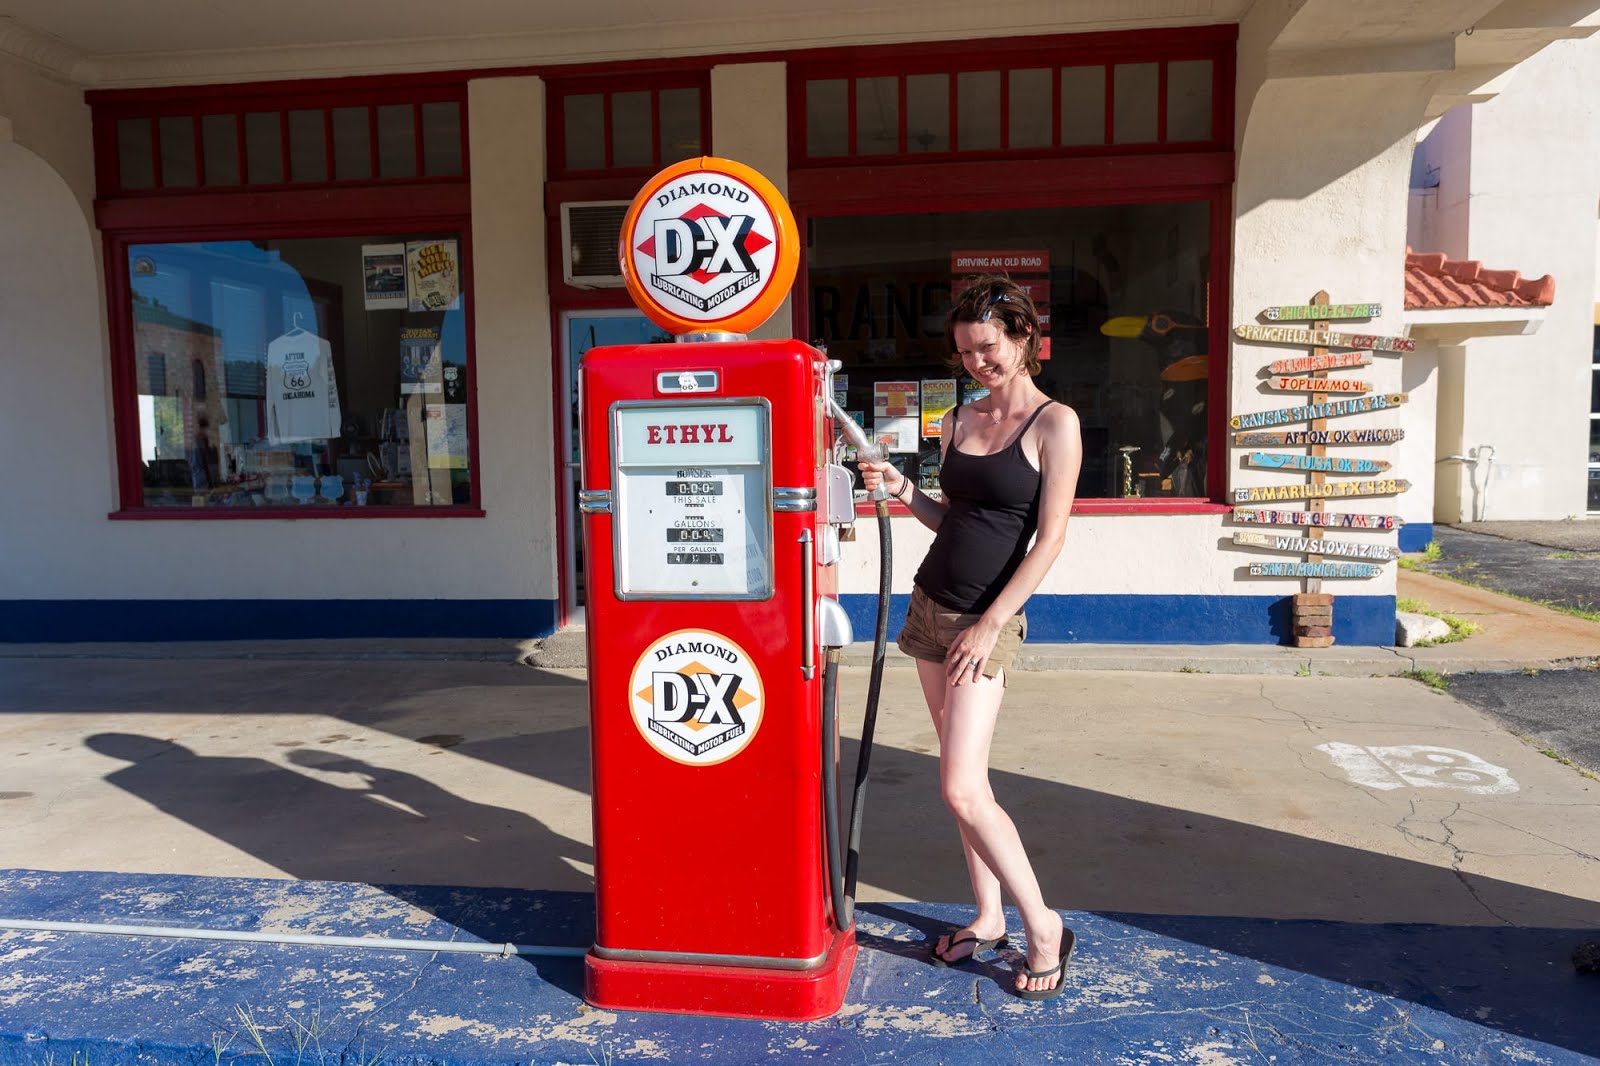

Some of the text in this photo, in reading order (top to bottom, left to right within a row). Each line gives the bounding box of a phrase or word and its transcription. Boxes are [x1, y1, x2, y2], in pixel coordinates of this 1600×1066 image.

[657, 183, 750, 208] DIAMOND
[957, 258, 1042, 267] DRIVING AN OLD ROAD
[652, 271, 759, 309] LUBRICATING MOTOR FUEL
[1280, 305, 1329, 320] CHICAGO
[1323, 332, 1341, 346] 418
[290, 376, 305, 387] 66
[283, 391, 315, 400] OKLAHOMA
[1241, 409, 1289, 428] KANSAS
[647, 424, 734, 444] ETHYL
[1367, 480, 1397, 494] 438
[673, 496, 716, 504] THIS SALE
[674, 520, 715, 528] GALLONS
[1257, 510, 1337, 526] ALBUQUERQUE
[1371, 516, 1394, 529] 726
[1262, 562, 1296, 577] SANTA
[654, 642, 738, 664] DIAMOND
[650, 719, 744, 754] LUBRICATING MOTOR FUEL
